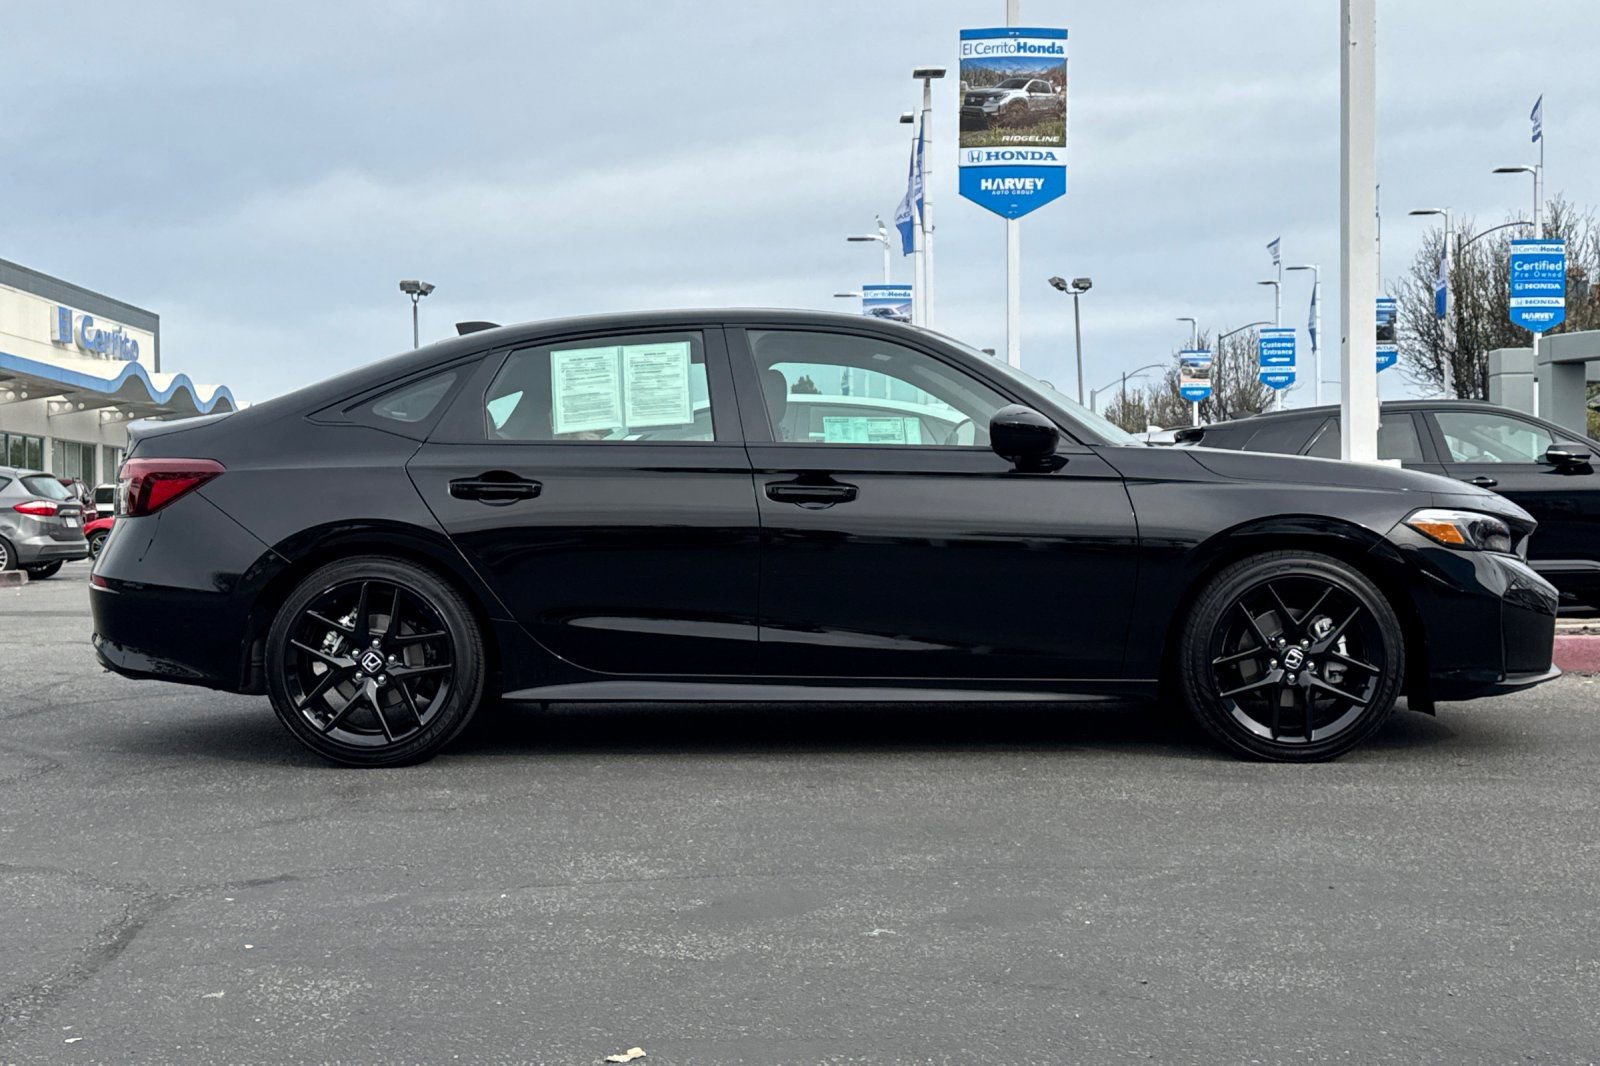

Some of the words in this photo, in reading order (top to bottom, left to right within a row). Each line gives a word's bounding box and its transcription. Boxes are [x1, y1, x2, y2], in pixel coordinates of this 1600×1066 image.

[962, 43, 972, 55] El
[985, 150, 1058, 161] HONDA
[980, 178, 1045, 190] HARVEY
[1514, 260, 1562, 271] Certified
[1521, 312, 1555, 320] HARVEY
[56, 306, 72, 343] El
[78, 315, 139, 361] Cerrito
